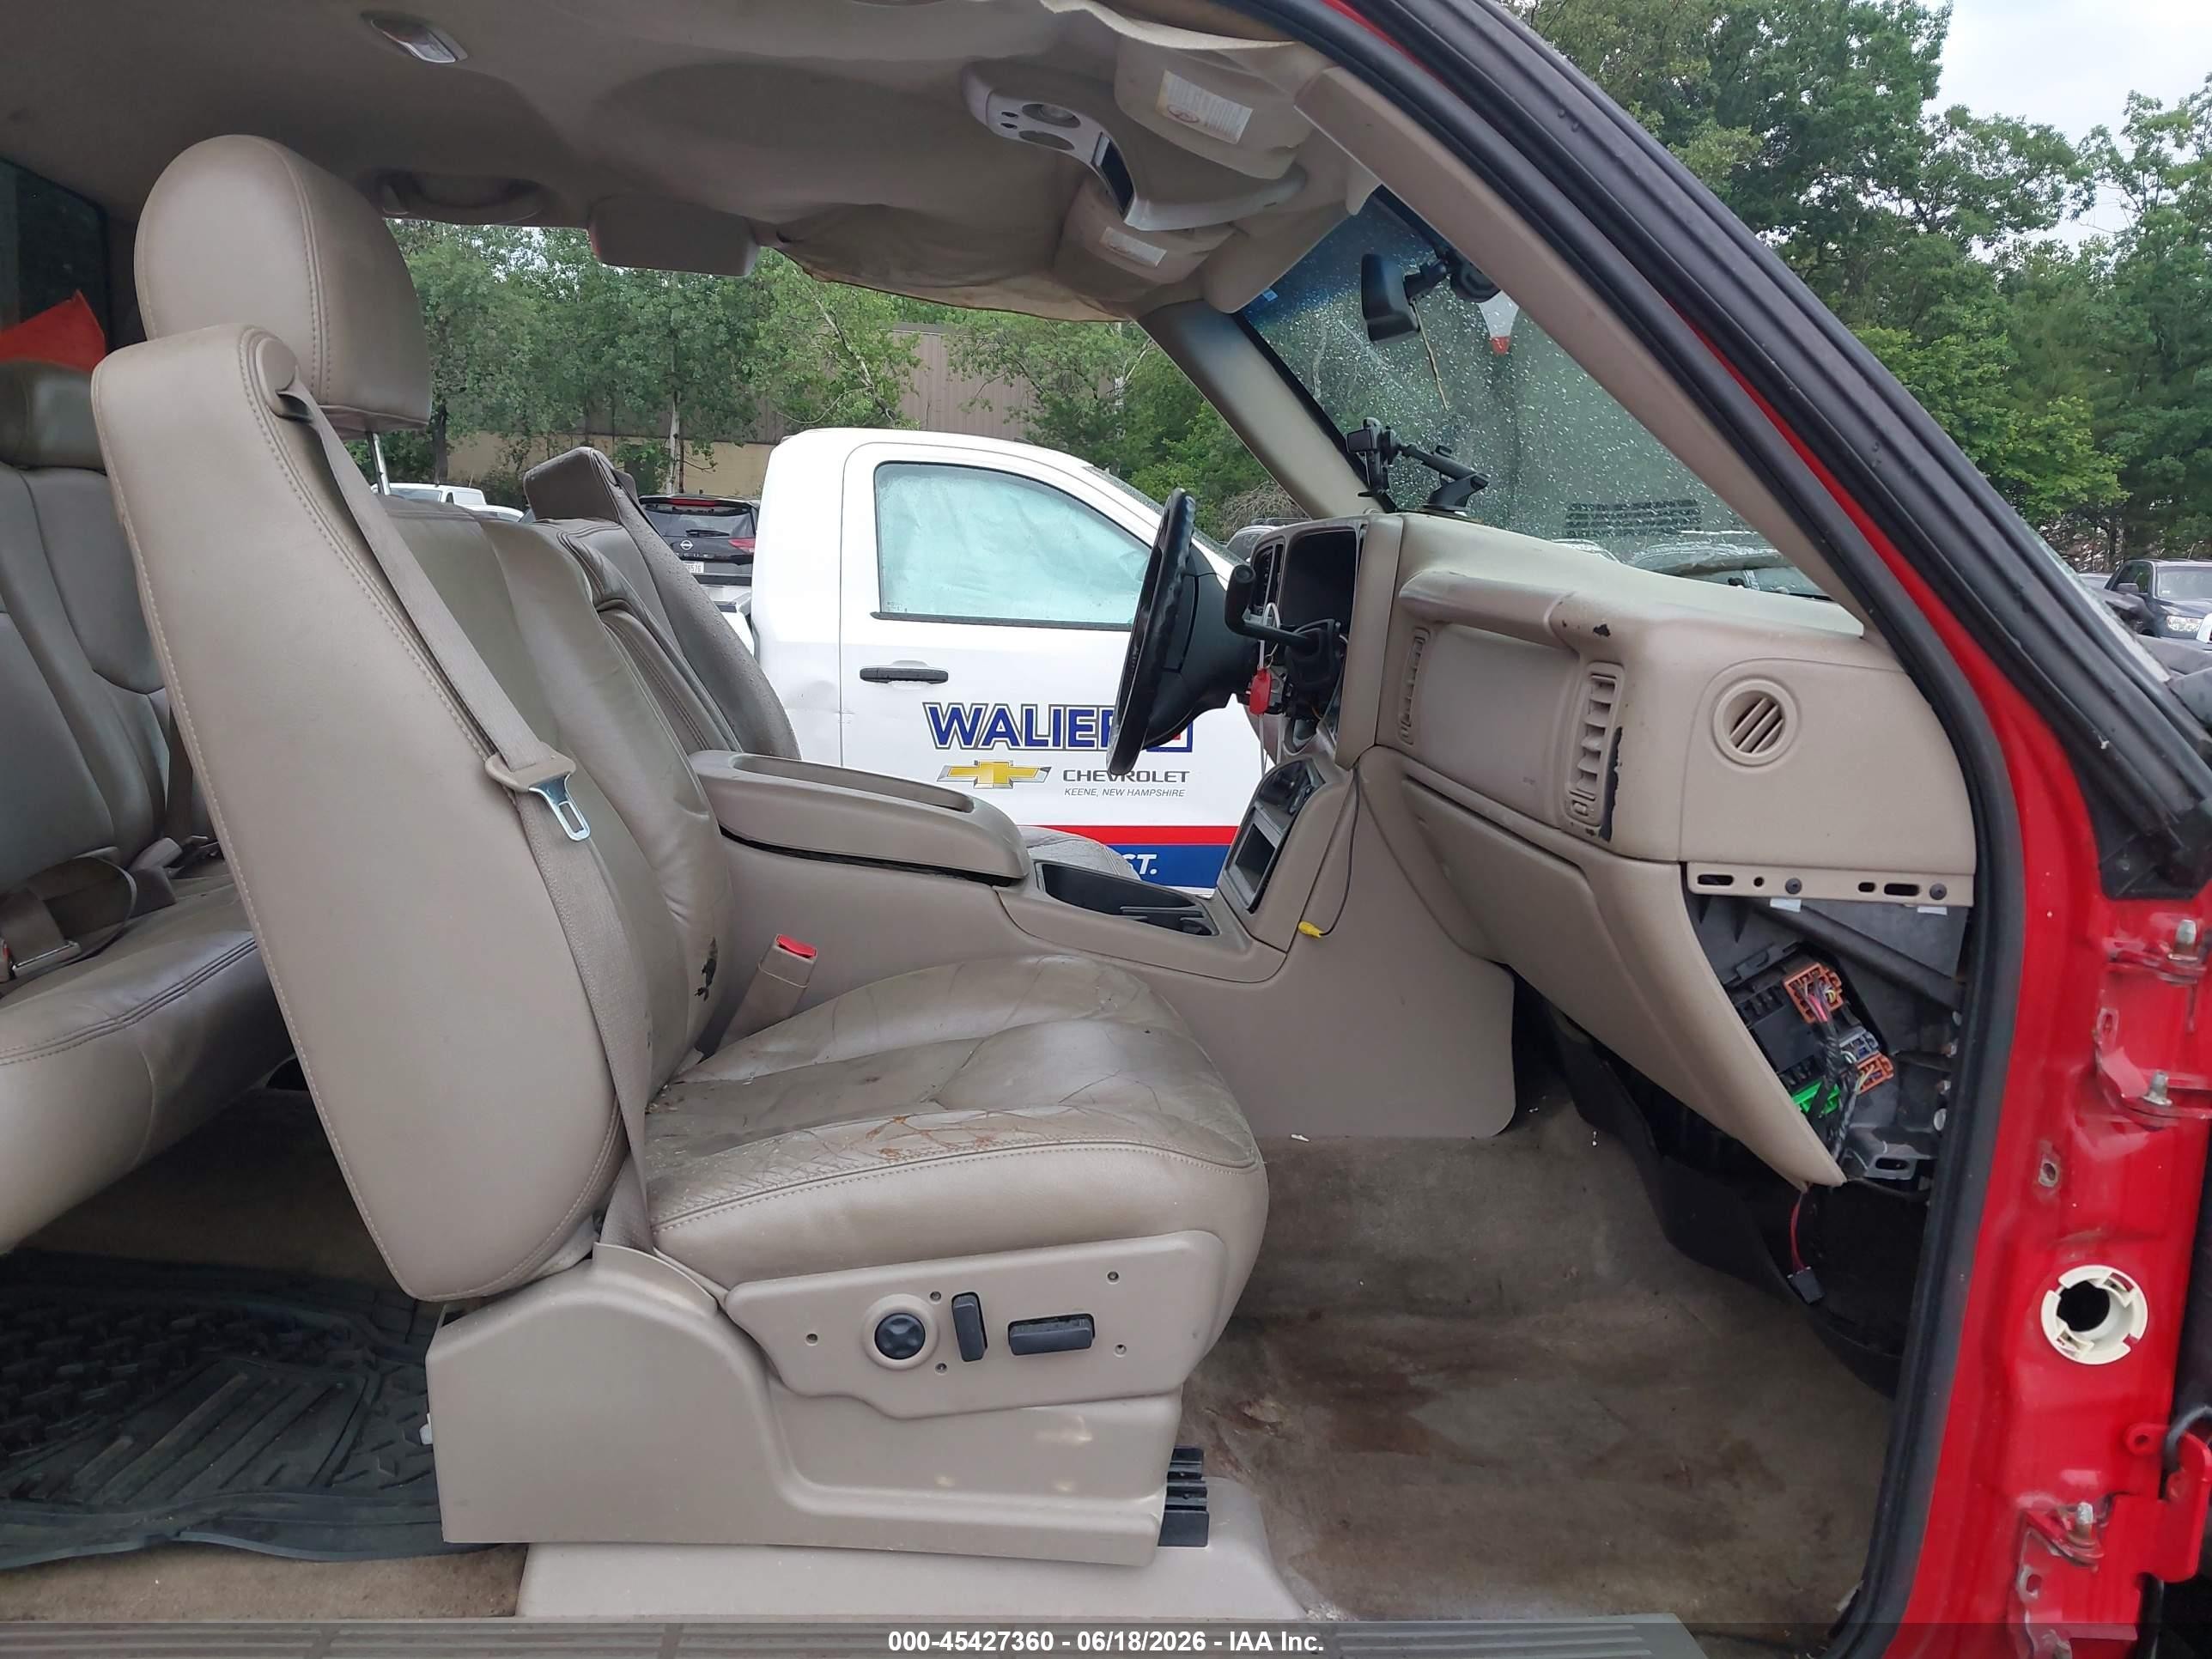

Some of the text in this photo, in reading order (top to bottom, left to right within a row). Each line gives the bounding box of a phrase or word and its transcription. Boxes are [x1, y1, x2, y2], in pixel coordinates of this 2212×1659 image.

[1063, 769, 1190, 782] CHEVROLET
[1064, 788, 1186, 798] KEENE, NEW HAMPSHIRE
[1122, 854, 1158, 875] T.
